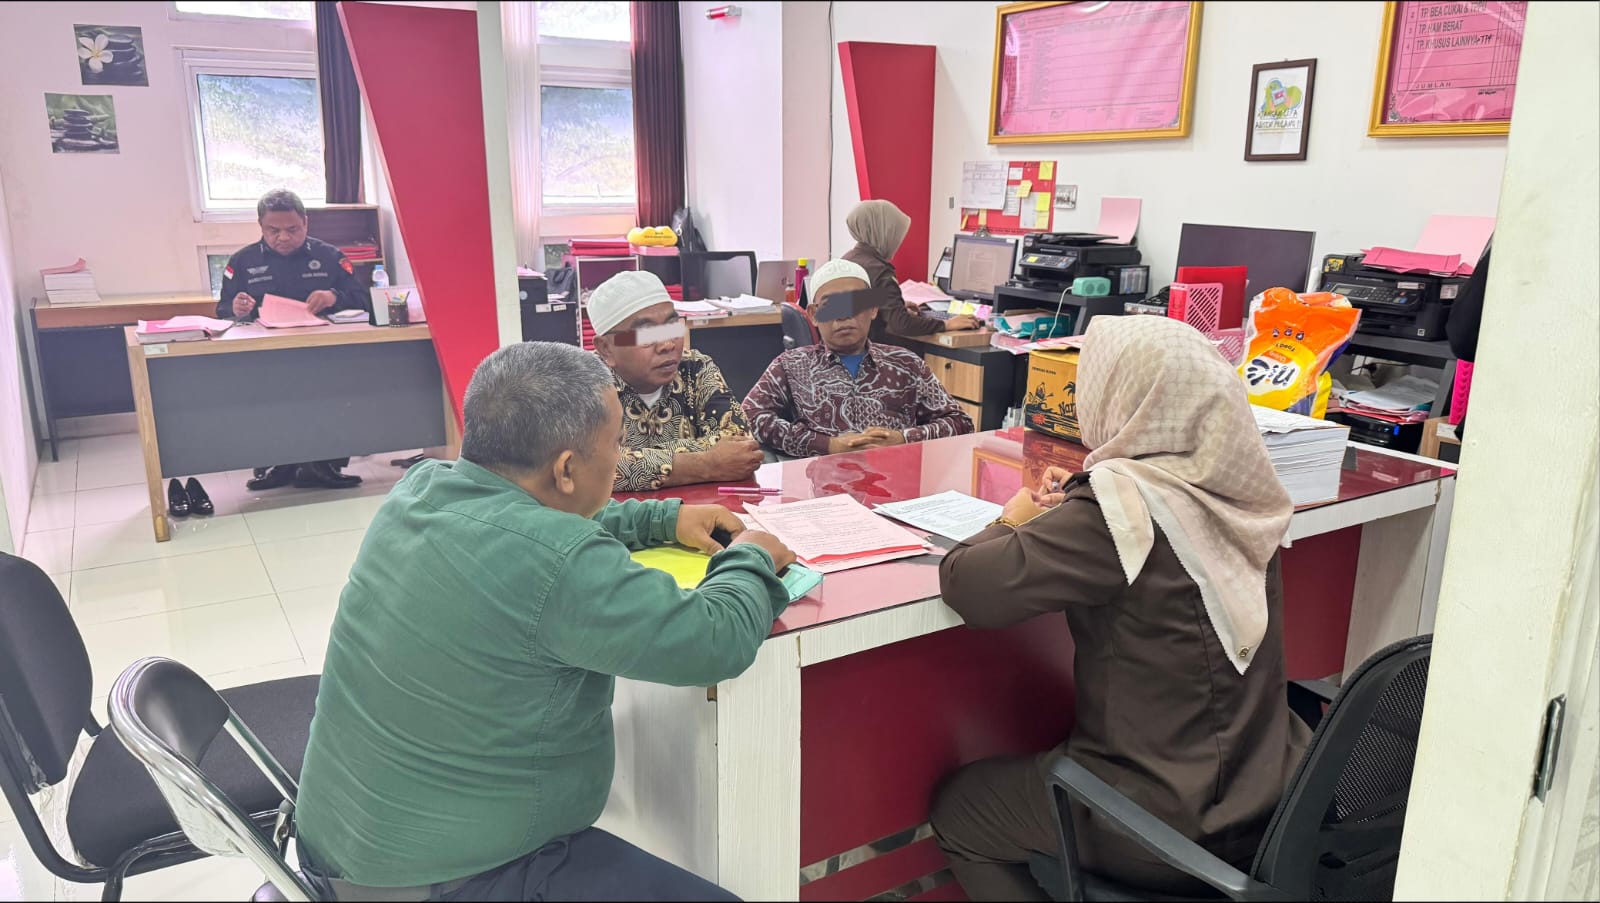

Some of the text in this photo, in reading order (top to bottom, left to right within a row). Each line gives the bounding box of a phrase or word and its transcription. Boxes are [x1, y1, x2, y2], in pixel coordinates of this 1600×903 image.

[1430, 6, 1444, 17] BEA
[1444, 4, 1463, 15] CUKAI
[1428, 22, 1443, 32] HAM
[1443, 20, 1464, 31] BERAT
[1425, 37, 1450, 49] KHUSUS
[1451, 36, 1477, 48] LAINNYA
